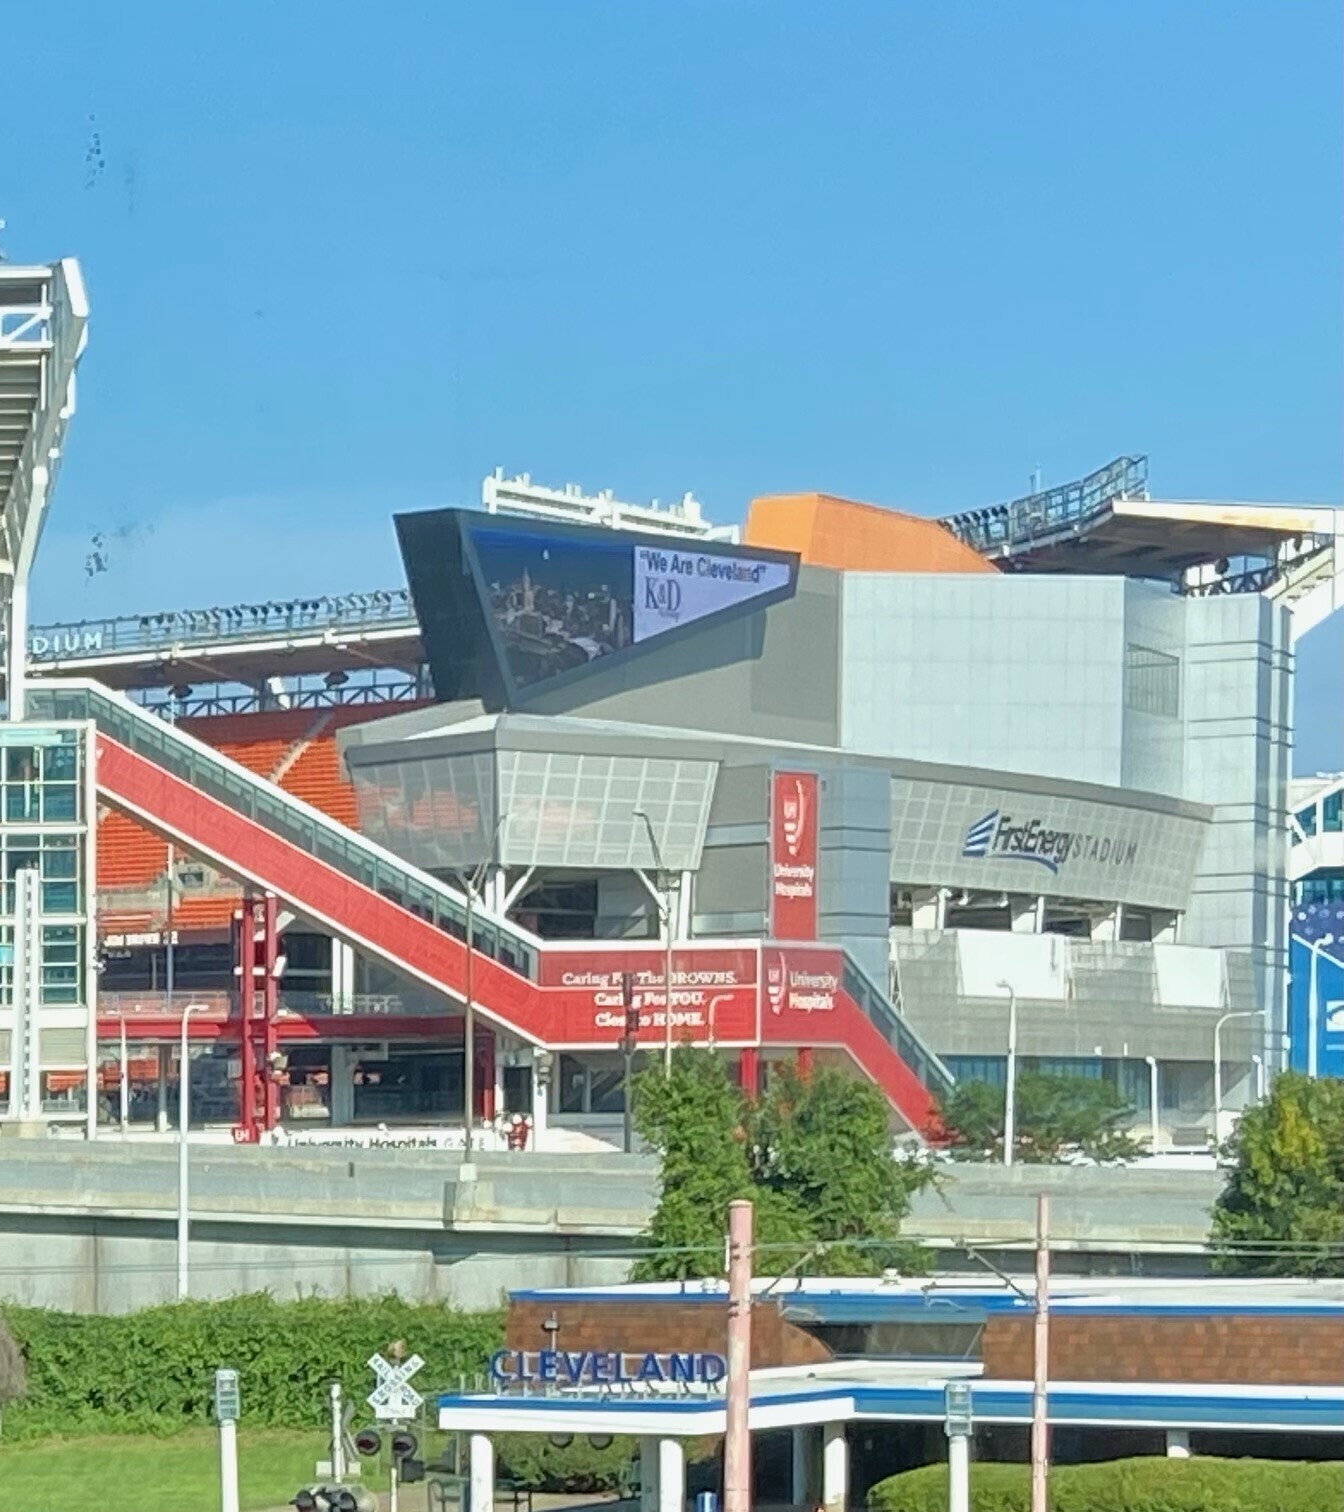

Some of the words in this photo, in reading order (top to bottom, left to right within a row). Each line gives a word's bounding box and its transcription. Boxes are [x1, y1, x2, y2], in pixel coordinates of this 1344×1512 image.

[671, 554, 694, 575] Are
[991, 815, 1074, 864] FirstEnergy
[1072, 832, 1138, 865] STADIUM
[773, 863, 814, 882] University
[562, 972, 610, 988] Caring
[789, 971, 838, 994] University
[788, 992, 834, 1013] Hospitals
[491, 1349, 728, 1383] CLEVELAND
